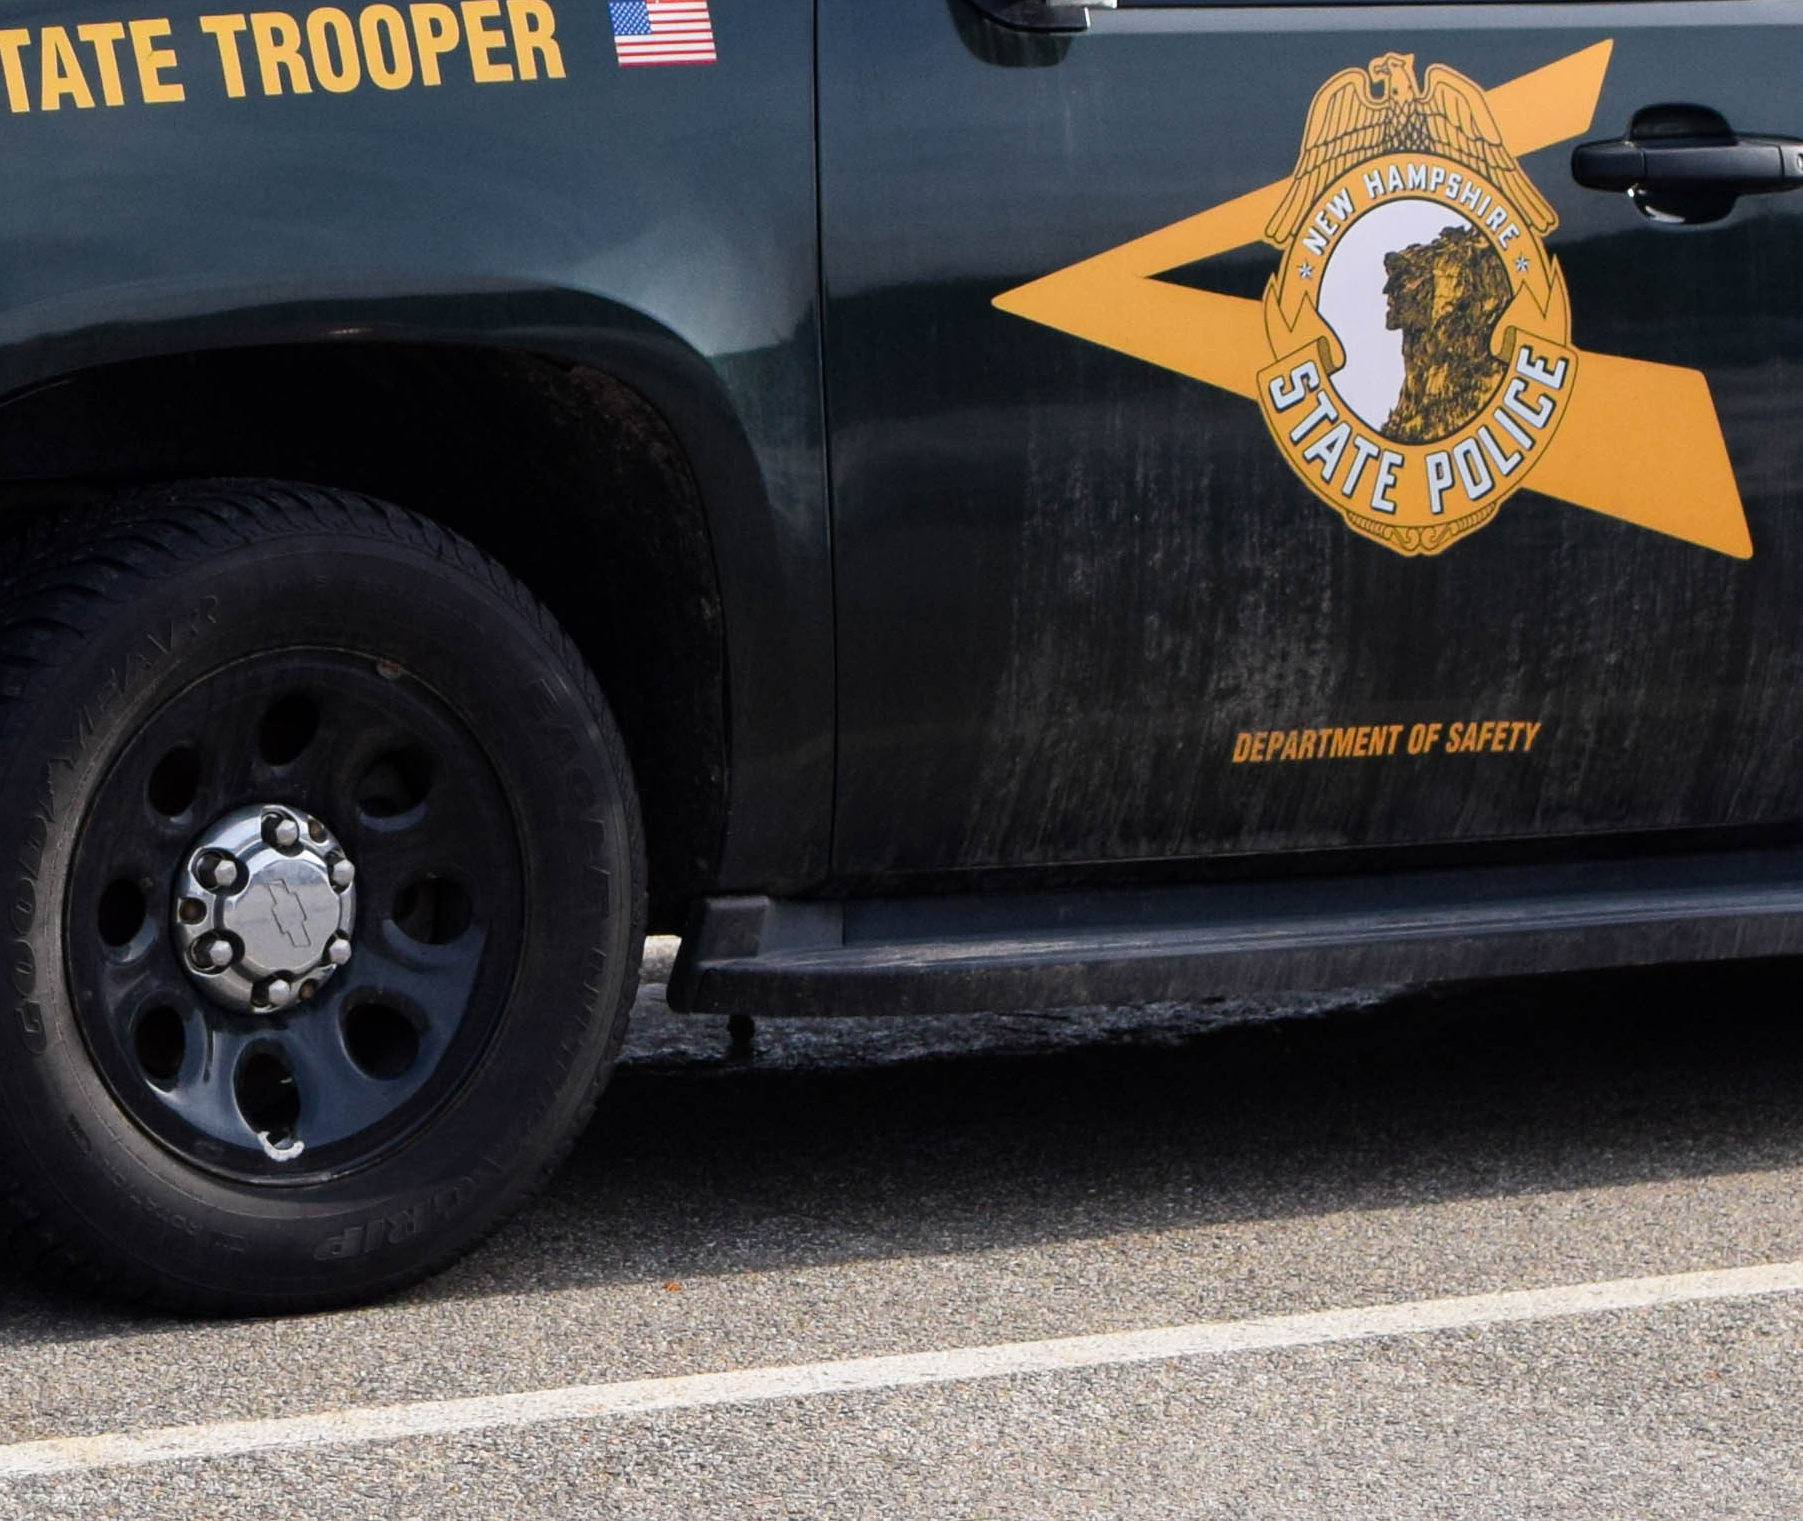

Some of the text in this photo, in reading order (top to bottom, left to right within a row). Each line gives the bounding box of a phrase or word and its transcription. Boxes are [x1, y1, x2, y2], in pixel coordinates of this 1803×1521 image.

[1300, 162, 1520, 257] NEW HAMPSHIRE
[1269, 344, 1569, 515] STATE POLICE
[1232, 720, 1542, 764] DEPARTMENT OF SAFETY
